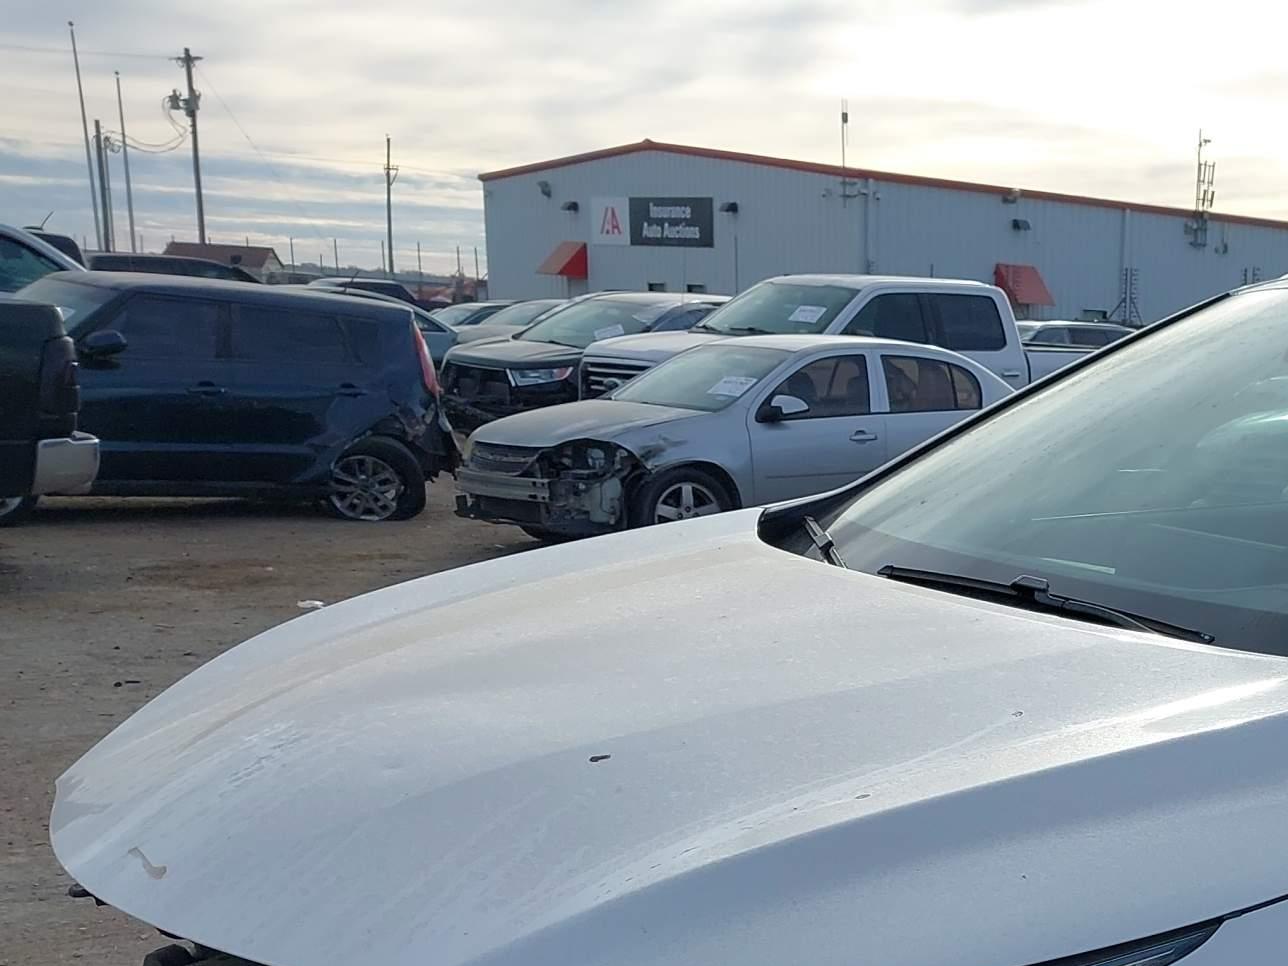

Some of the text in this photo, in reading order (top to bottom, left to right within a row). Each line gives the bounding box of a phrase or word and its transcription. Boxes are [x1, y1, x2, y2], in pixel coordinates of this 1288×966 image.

[649, 202, 691, 218] Insurance
[642, 222, 700, 239] Auto Auctions
